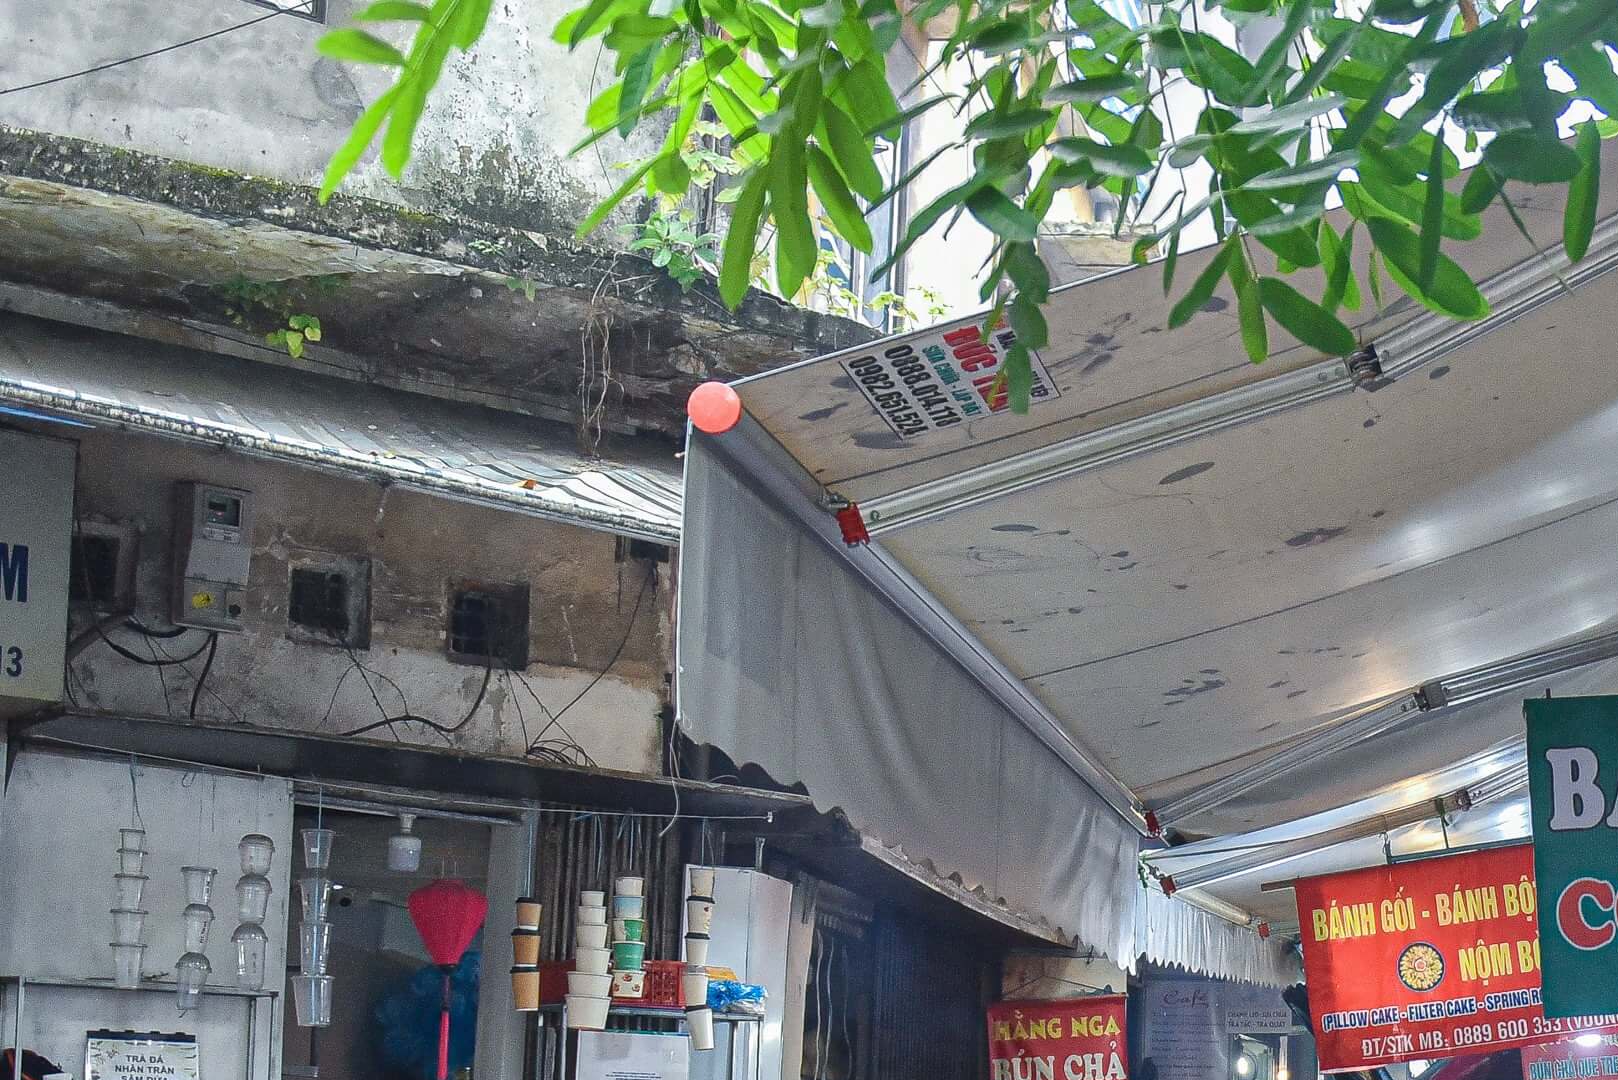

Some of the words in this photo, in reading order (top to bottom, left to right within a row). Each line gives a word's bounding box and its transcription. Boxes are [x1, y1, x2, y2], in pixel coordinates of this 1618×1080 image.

[1312, 899, 1376, 942] BÁNH
[1380, 886, 1416, 933] GỐI
[1435, 884, 1499, 927] BÁNH
[1502, 875, 1537, 922] BỘ
[1458, 938, 1513, 986] NỘM
[1071, 1015, 1121, 1038] NGA
[1322, 1012, 1373, 1033] (PILLOW
[1371, 1007, 1400, 1026] CAKE
[1407, 1001, 1444, 1022] FILTER
[1446, 996, 1477, 1017] CAKE
[1485, 989, 1529, 1013] SPRING
[1361, 1034, 1414, 1057] ĐT/STK
[1418, 1029, 1449, 1049] MB:
[1453, 1024, 1493, 1046] 0889
[1497, 1018, 1528, 1040] 600
[1533, 1014, 1562, 1034] 353
[1577, 1057, 1600, 1079] QUE
